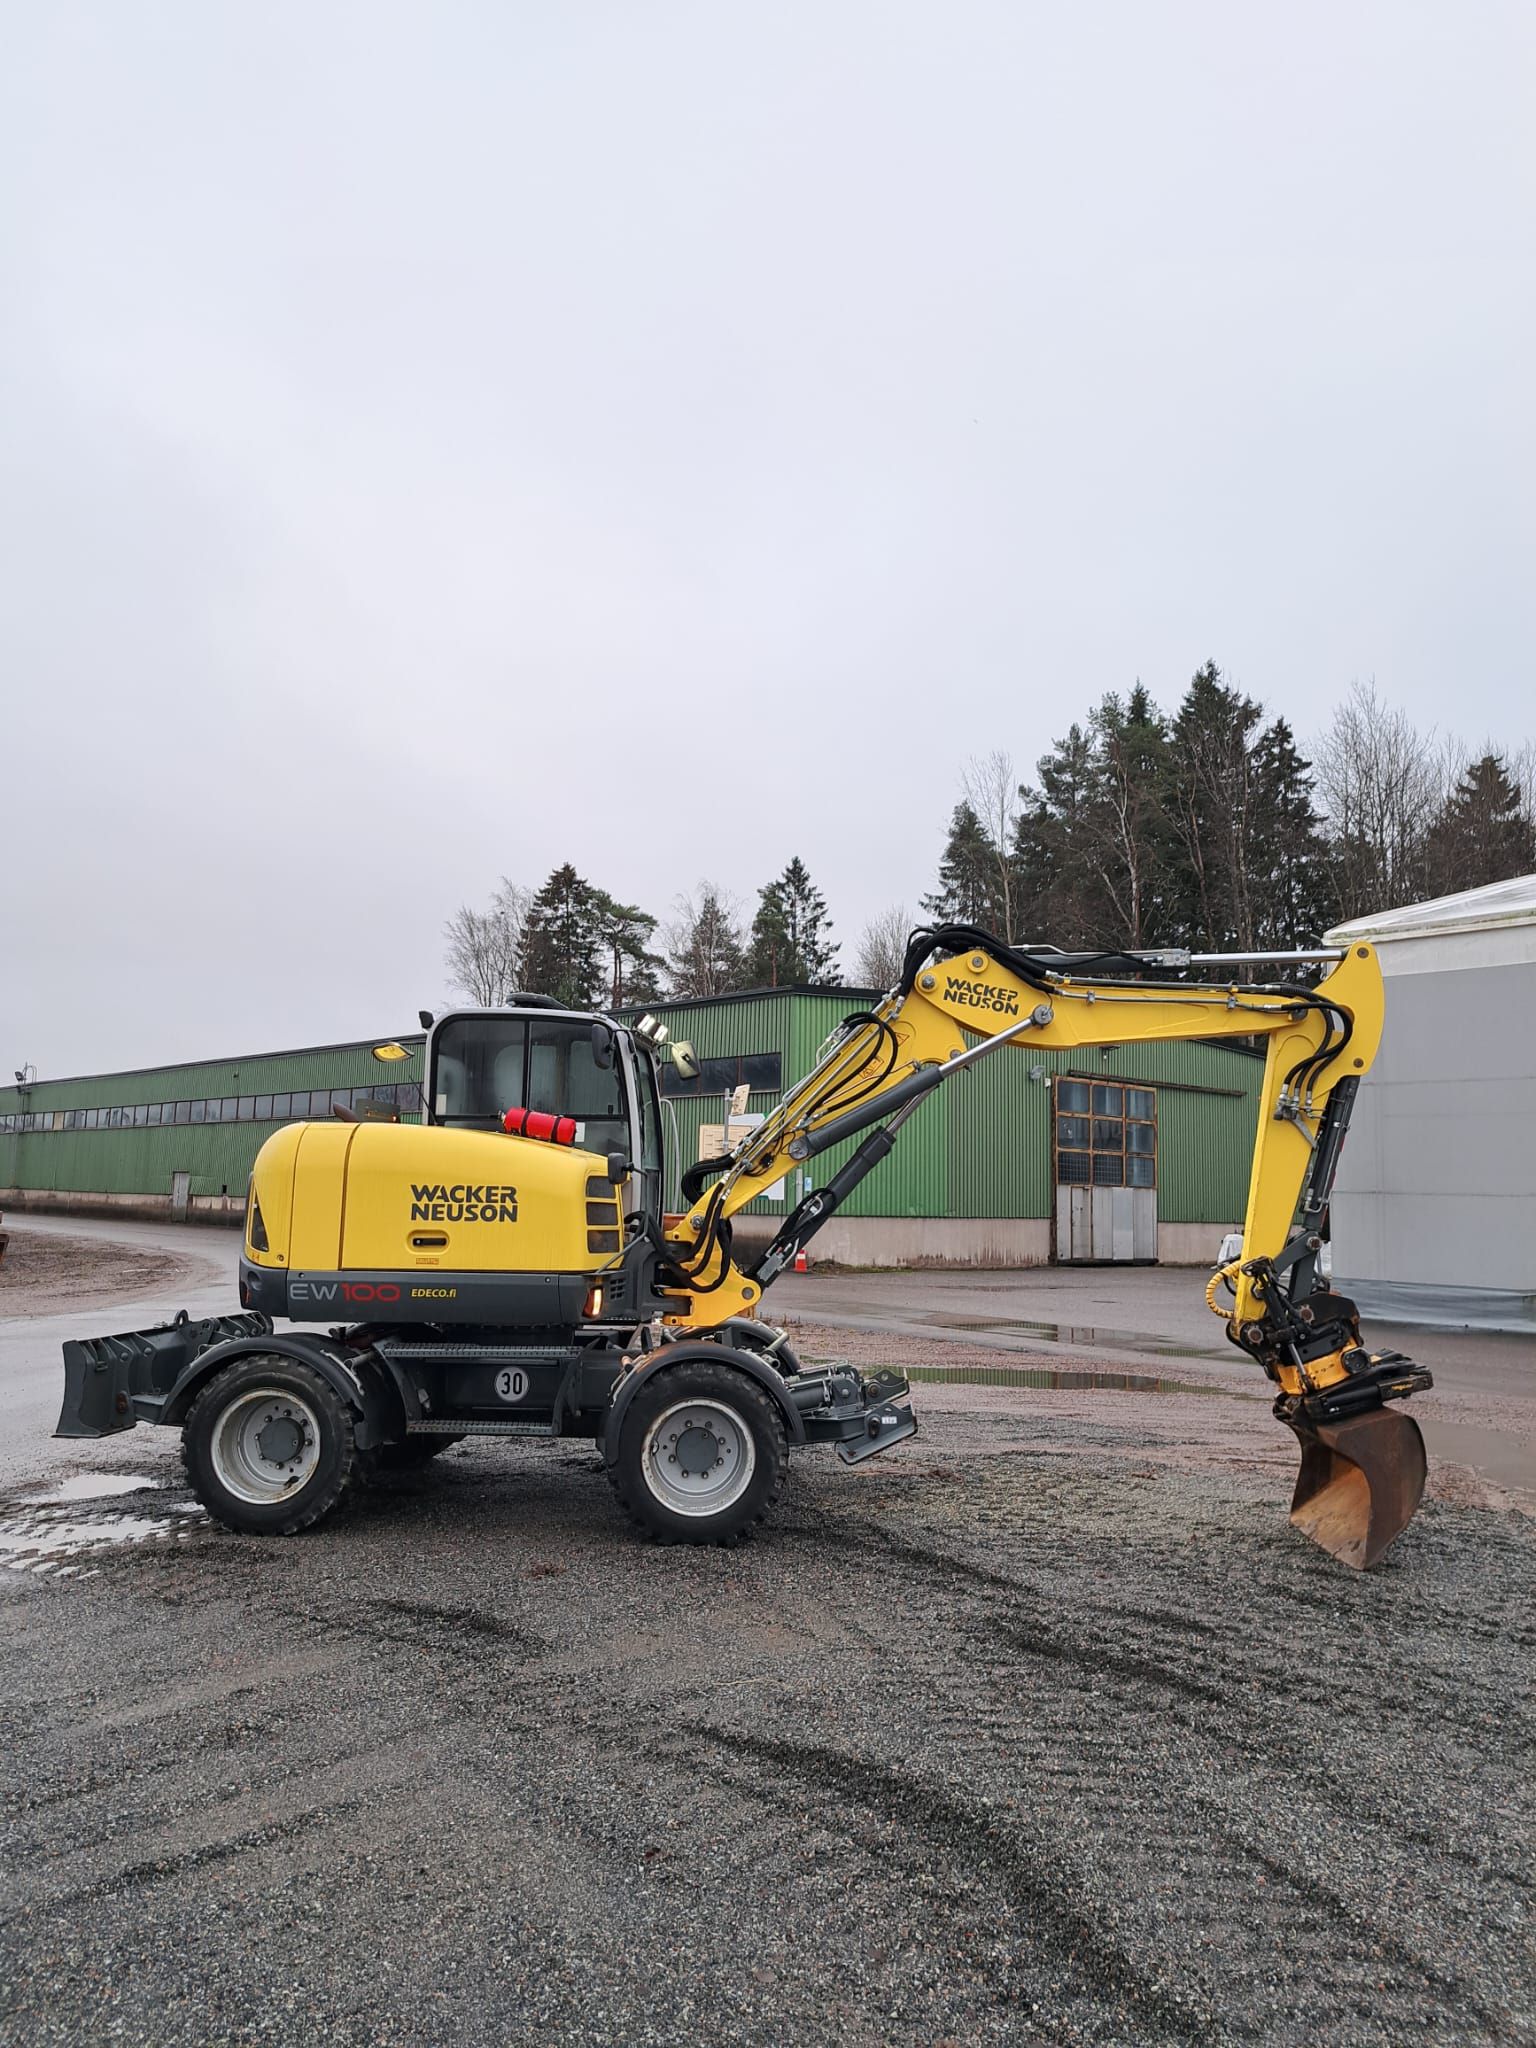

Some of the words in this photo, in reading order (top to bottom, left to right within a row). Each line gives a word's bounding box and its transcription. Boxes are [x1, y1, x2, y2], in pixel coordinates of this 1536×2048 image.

[943, 989, 1019, 1015] NEUSON
[411, 1184, 518, 1203] WACKER
[411, 1203, 518, 1222] NEUSON
[411, 1288, 457, 1298] EDECO.fi
[501, 1372, 523, 1395] 30
